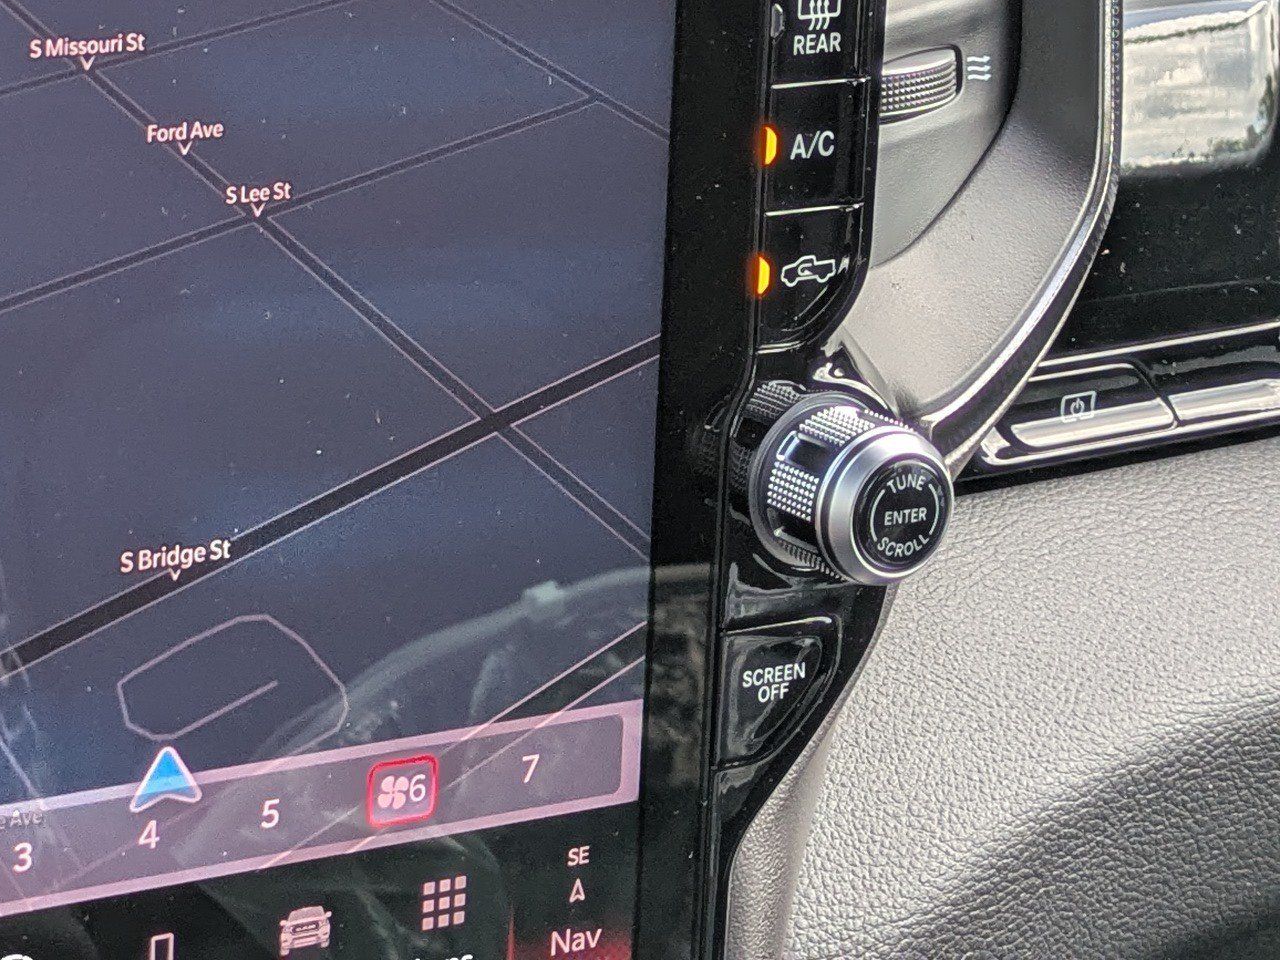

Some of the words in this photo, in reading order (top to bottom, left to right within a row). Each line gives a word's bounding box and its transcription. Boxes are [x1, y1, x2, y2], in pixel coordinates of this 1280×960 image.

[29, 39, 42, 59] S
[45, 34, 122, 57] Missouri
[125, 33, 146, 53] St
[792, 34, 842, 56] REAR
[146, 122, 188, 143] Ford
[190, 121, 224, 140] Ave
[789, 131, 835, 160] A/C
[225, 185, 238, 205] S
[240, 184, 271, 202] Lee
[273, 181, 292, 200] St
[886, 475, 927, 495] TUNE
[884, 507, 928, 527] ENTER
[120, 552, 134, 573] S
[137, 544, 207, 573] Bridge
[209, 539, 232, 560] St
[876, 533, 930, 559] SCROLL
[742, 662, 807, 688] SCREEN
[758, 683, 790, 704] OFF
[9, 809, 43, 828] Ave
[13, 841, 33, 873] 3
[138, 820, 160, 850] 4
[260, 798, 280, 829] 5
[409, 774, 426, 803] 6
[521, 754, 540, 784] 7
[567, 845, 591, 867] SE
[550, 927, 602, 956] Nav
